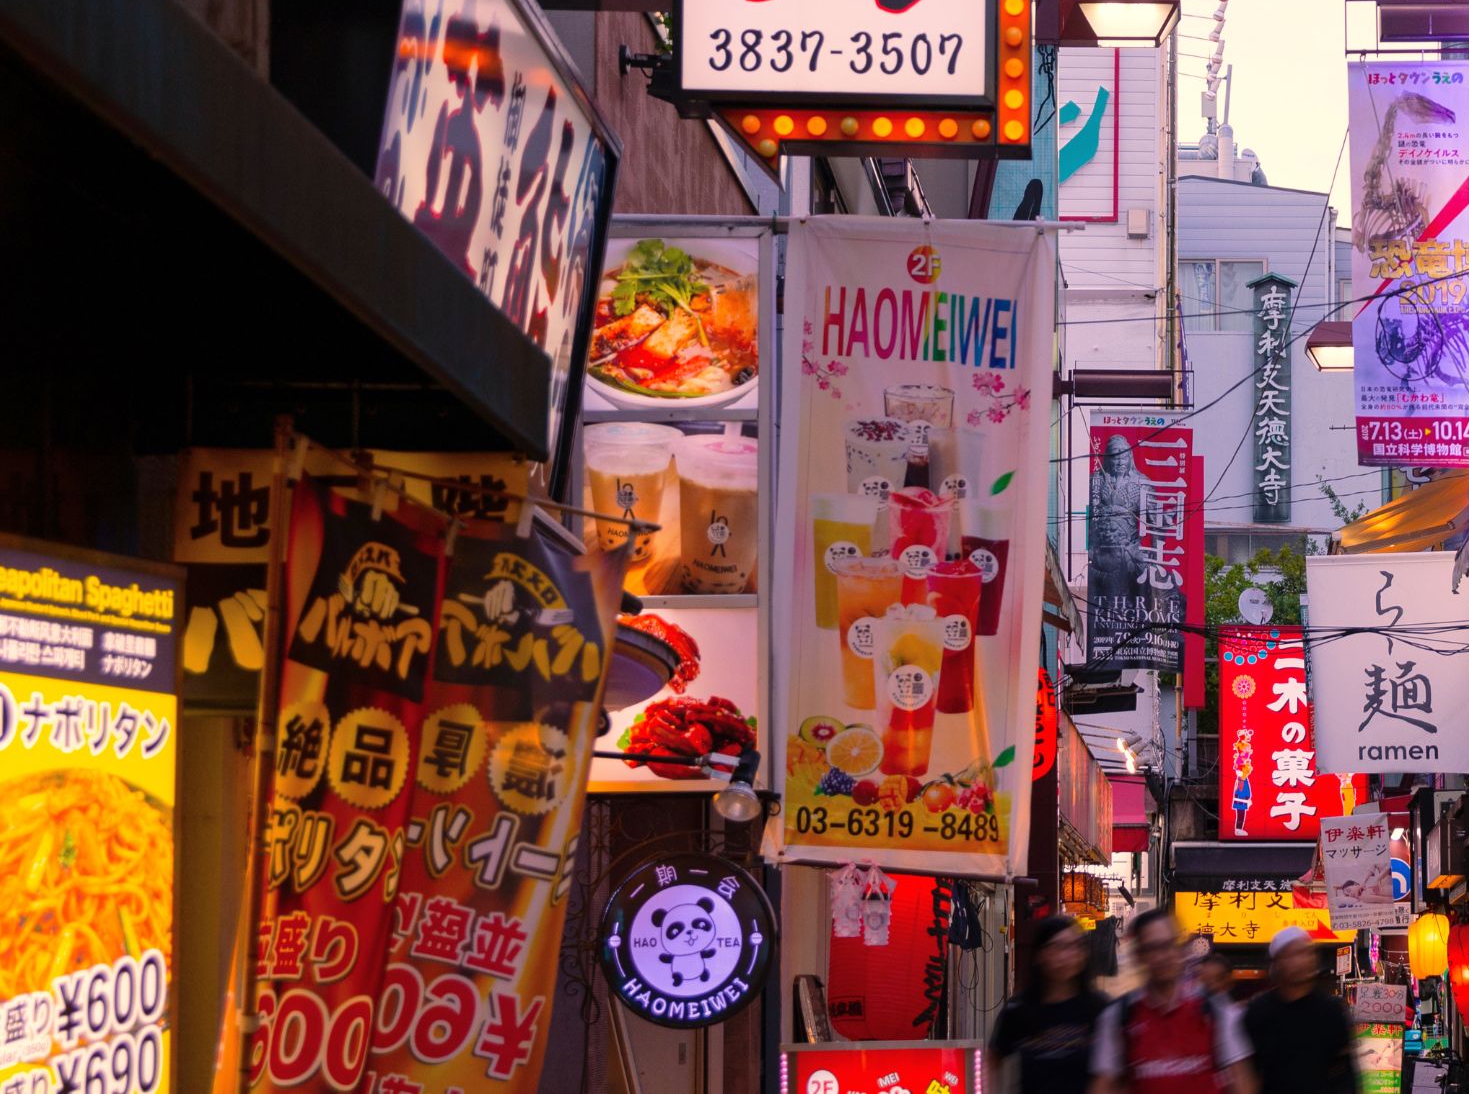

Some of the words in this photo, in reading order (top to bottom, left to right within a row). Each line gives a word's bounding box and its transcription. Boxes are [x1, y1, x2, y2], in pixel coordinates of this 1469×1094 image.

[709, 27, 964, 75] 3837-3507
[1368, 71, 1464, 85] ほっとタウンうえの
[911, 255, 942, 276] 2F
[1399, 280, 1467, 305] 2019
[822, 285, 1018, 369] HAOMEIWEI
[1373, 442, 1462, 457] 国立科学博物館
[85, 575, 174, 620] Spaghetti
[18, 692, 173, 759] ナポリタン
[1266, 637, 1317, 832] 二木の菓子
[1358, 744, 1439, 761] ramen
[1325, 844, 1387, 859] マッサージ
[633, 937, 657, 948] HAO
[717, 937, 740, 948] TEA
[58, 955, 162, 1042] ¥600
[623, 976, 750, 1020] HAOMEIWEI
[878, 1073, 900, 1088] MEI
